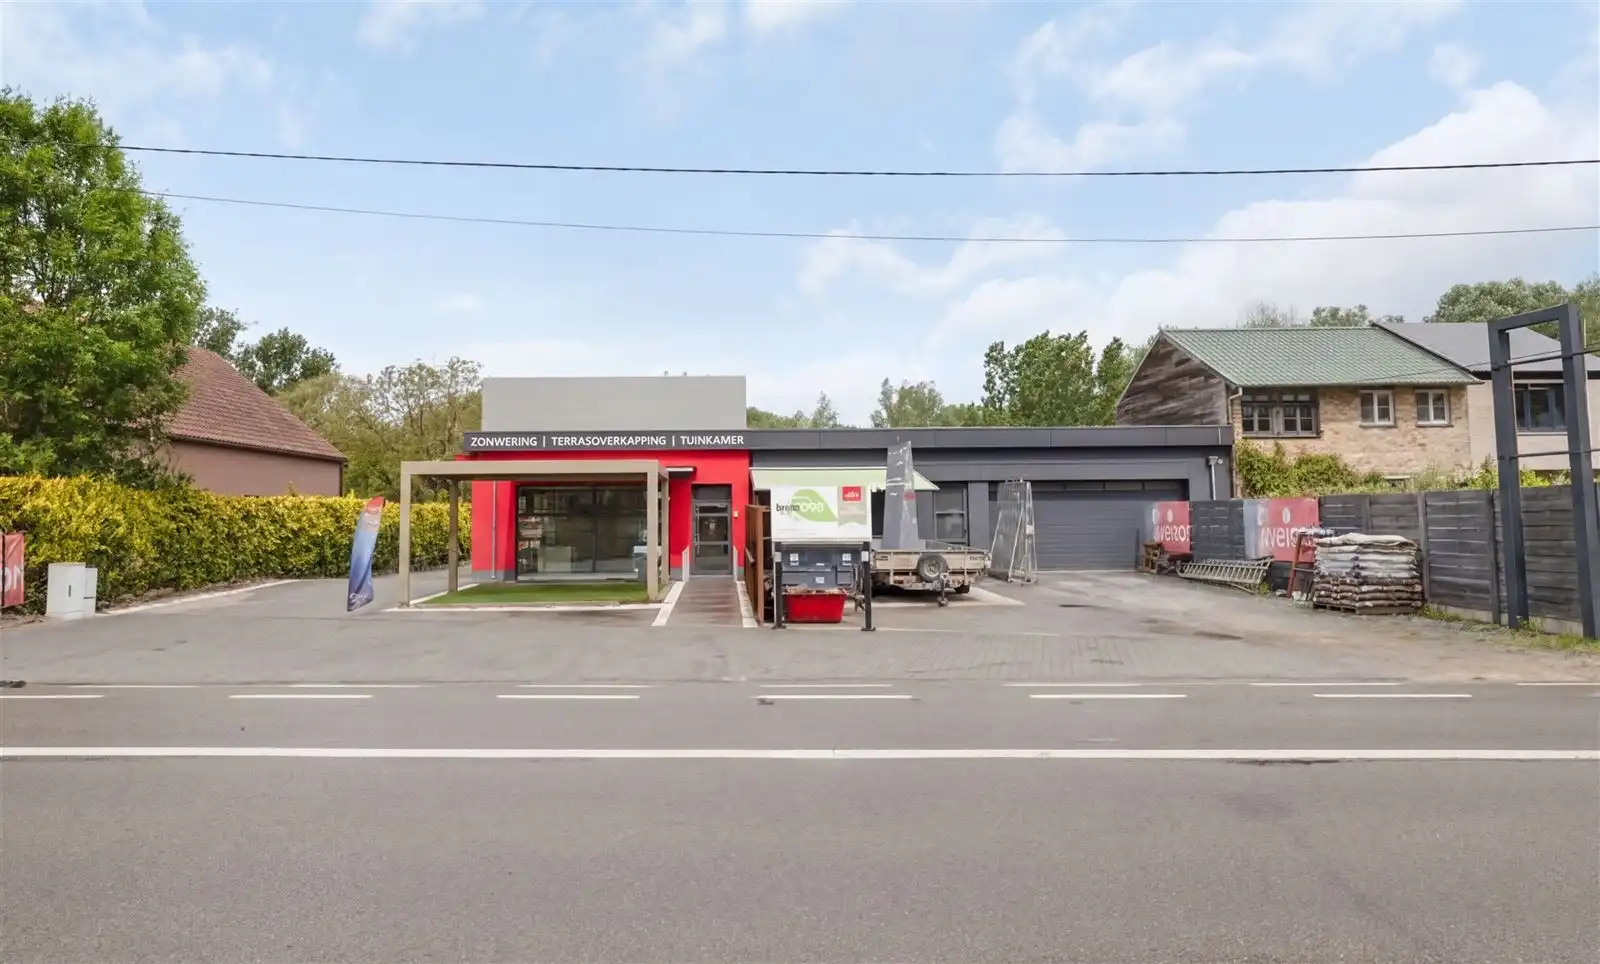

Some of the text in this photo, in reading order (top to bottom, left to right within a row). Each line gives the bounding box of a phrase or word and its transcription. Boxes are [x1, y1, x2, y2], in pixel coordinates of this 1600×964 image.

[470, 435, 745, 447] ZONWERING TERRASOVERKAPPING TUINKAMER
